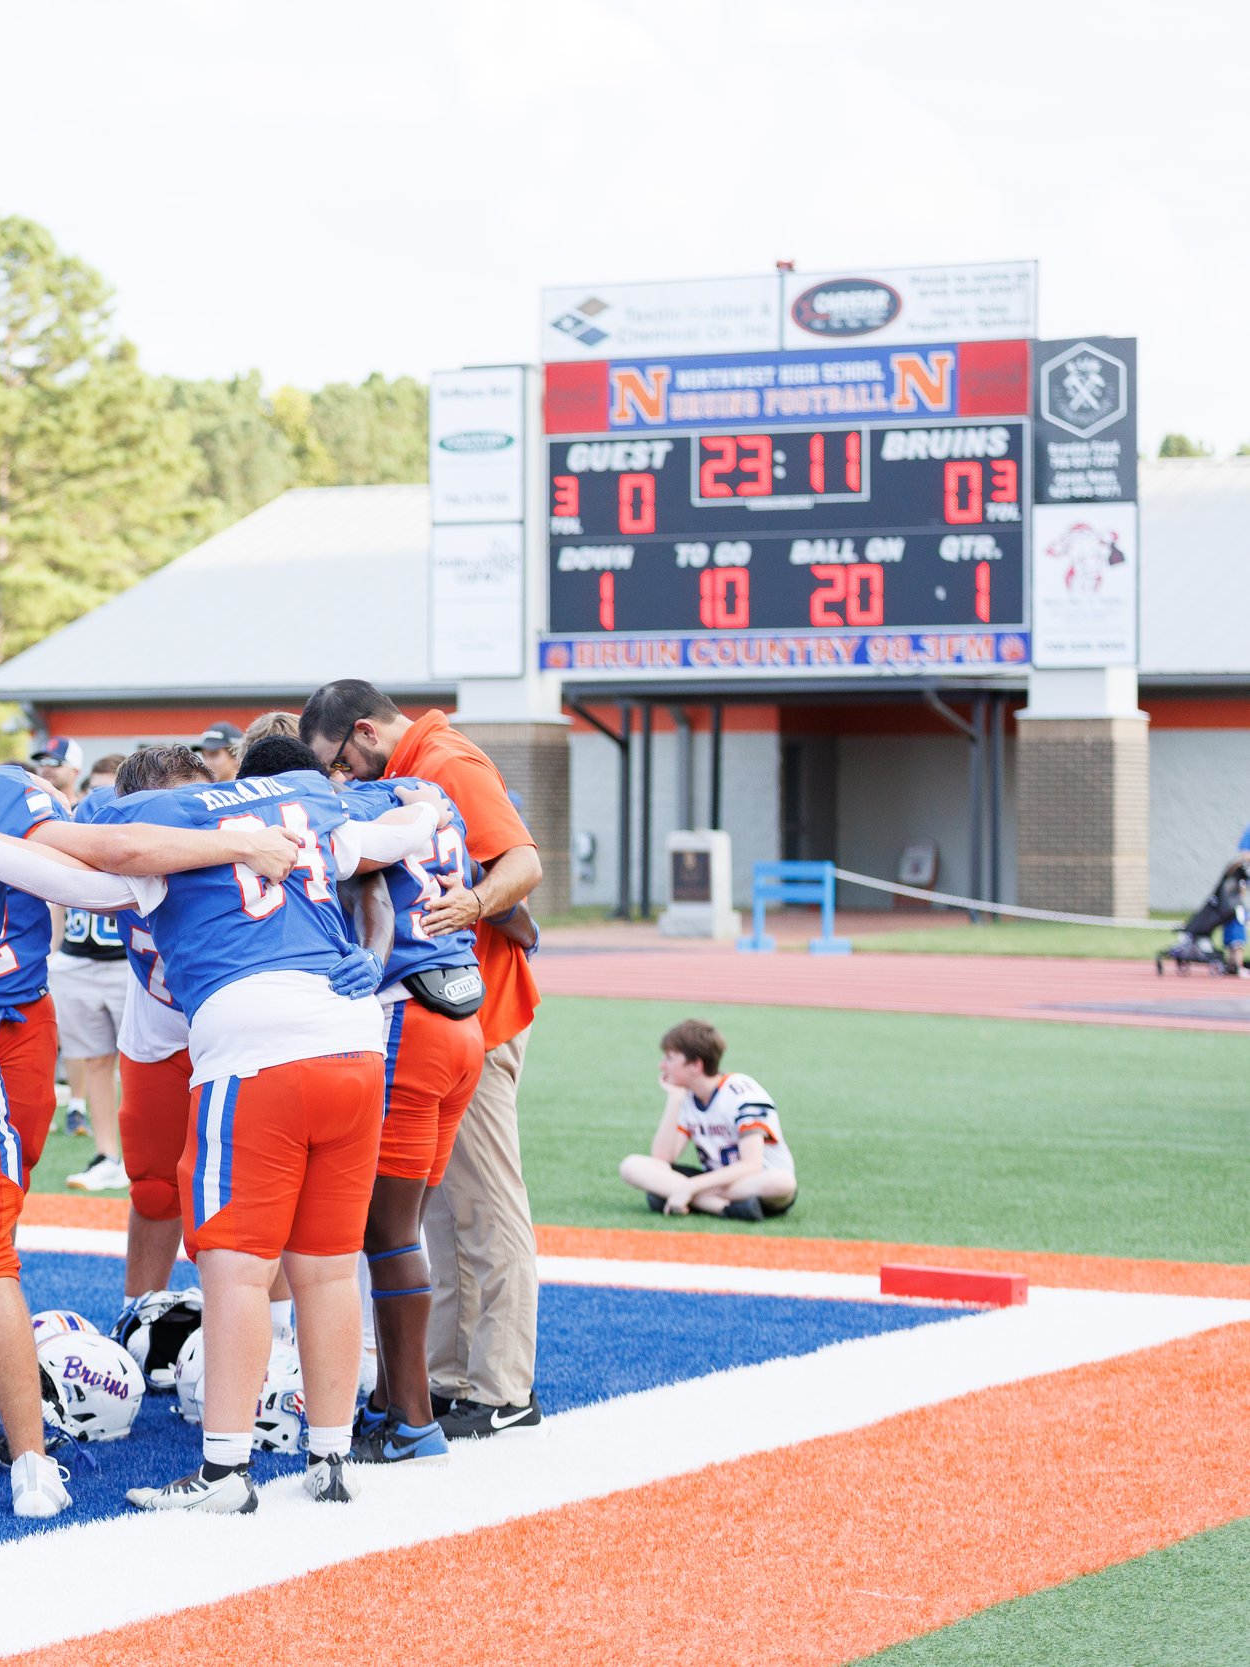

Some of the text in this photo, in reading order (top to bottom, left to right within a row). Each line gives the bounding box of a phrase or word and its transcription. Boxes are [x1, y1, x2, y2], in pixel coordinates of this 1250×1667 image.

[611, 366, 670, 425] N
[891, 352, 954, 412] N
[567, 440, 673, 472] GUEST
[882, 427, 1010, 460] BRUINS
[553, 475, 579, 517] 3
[618, 473, 656, 534] 0
[944, 461, 983, 524] 0
[557, 544, 635, 571] DOWN
[674, 540, 752, 568] TO GO
[789, 536, 906, 565] BALL ON
[938, 534, 1003, 562] QTR.
[599, 571, 615, 631] 1
[700, 567, 750, 629] 10
[810, 563, 884, 627] 20
[975, 561, 991, 623] 1
[575, 638, 681, 668] BRUIN
[689, 635, 862, 667] COUNTRY
[63, 1356, 129, 1400] Bruins
